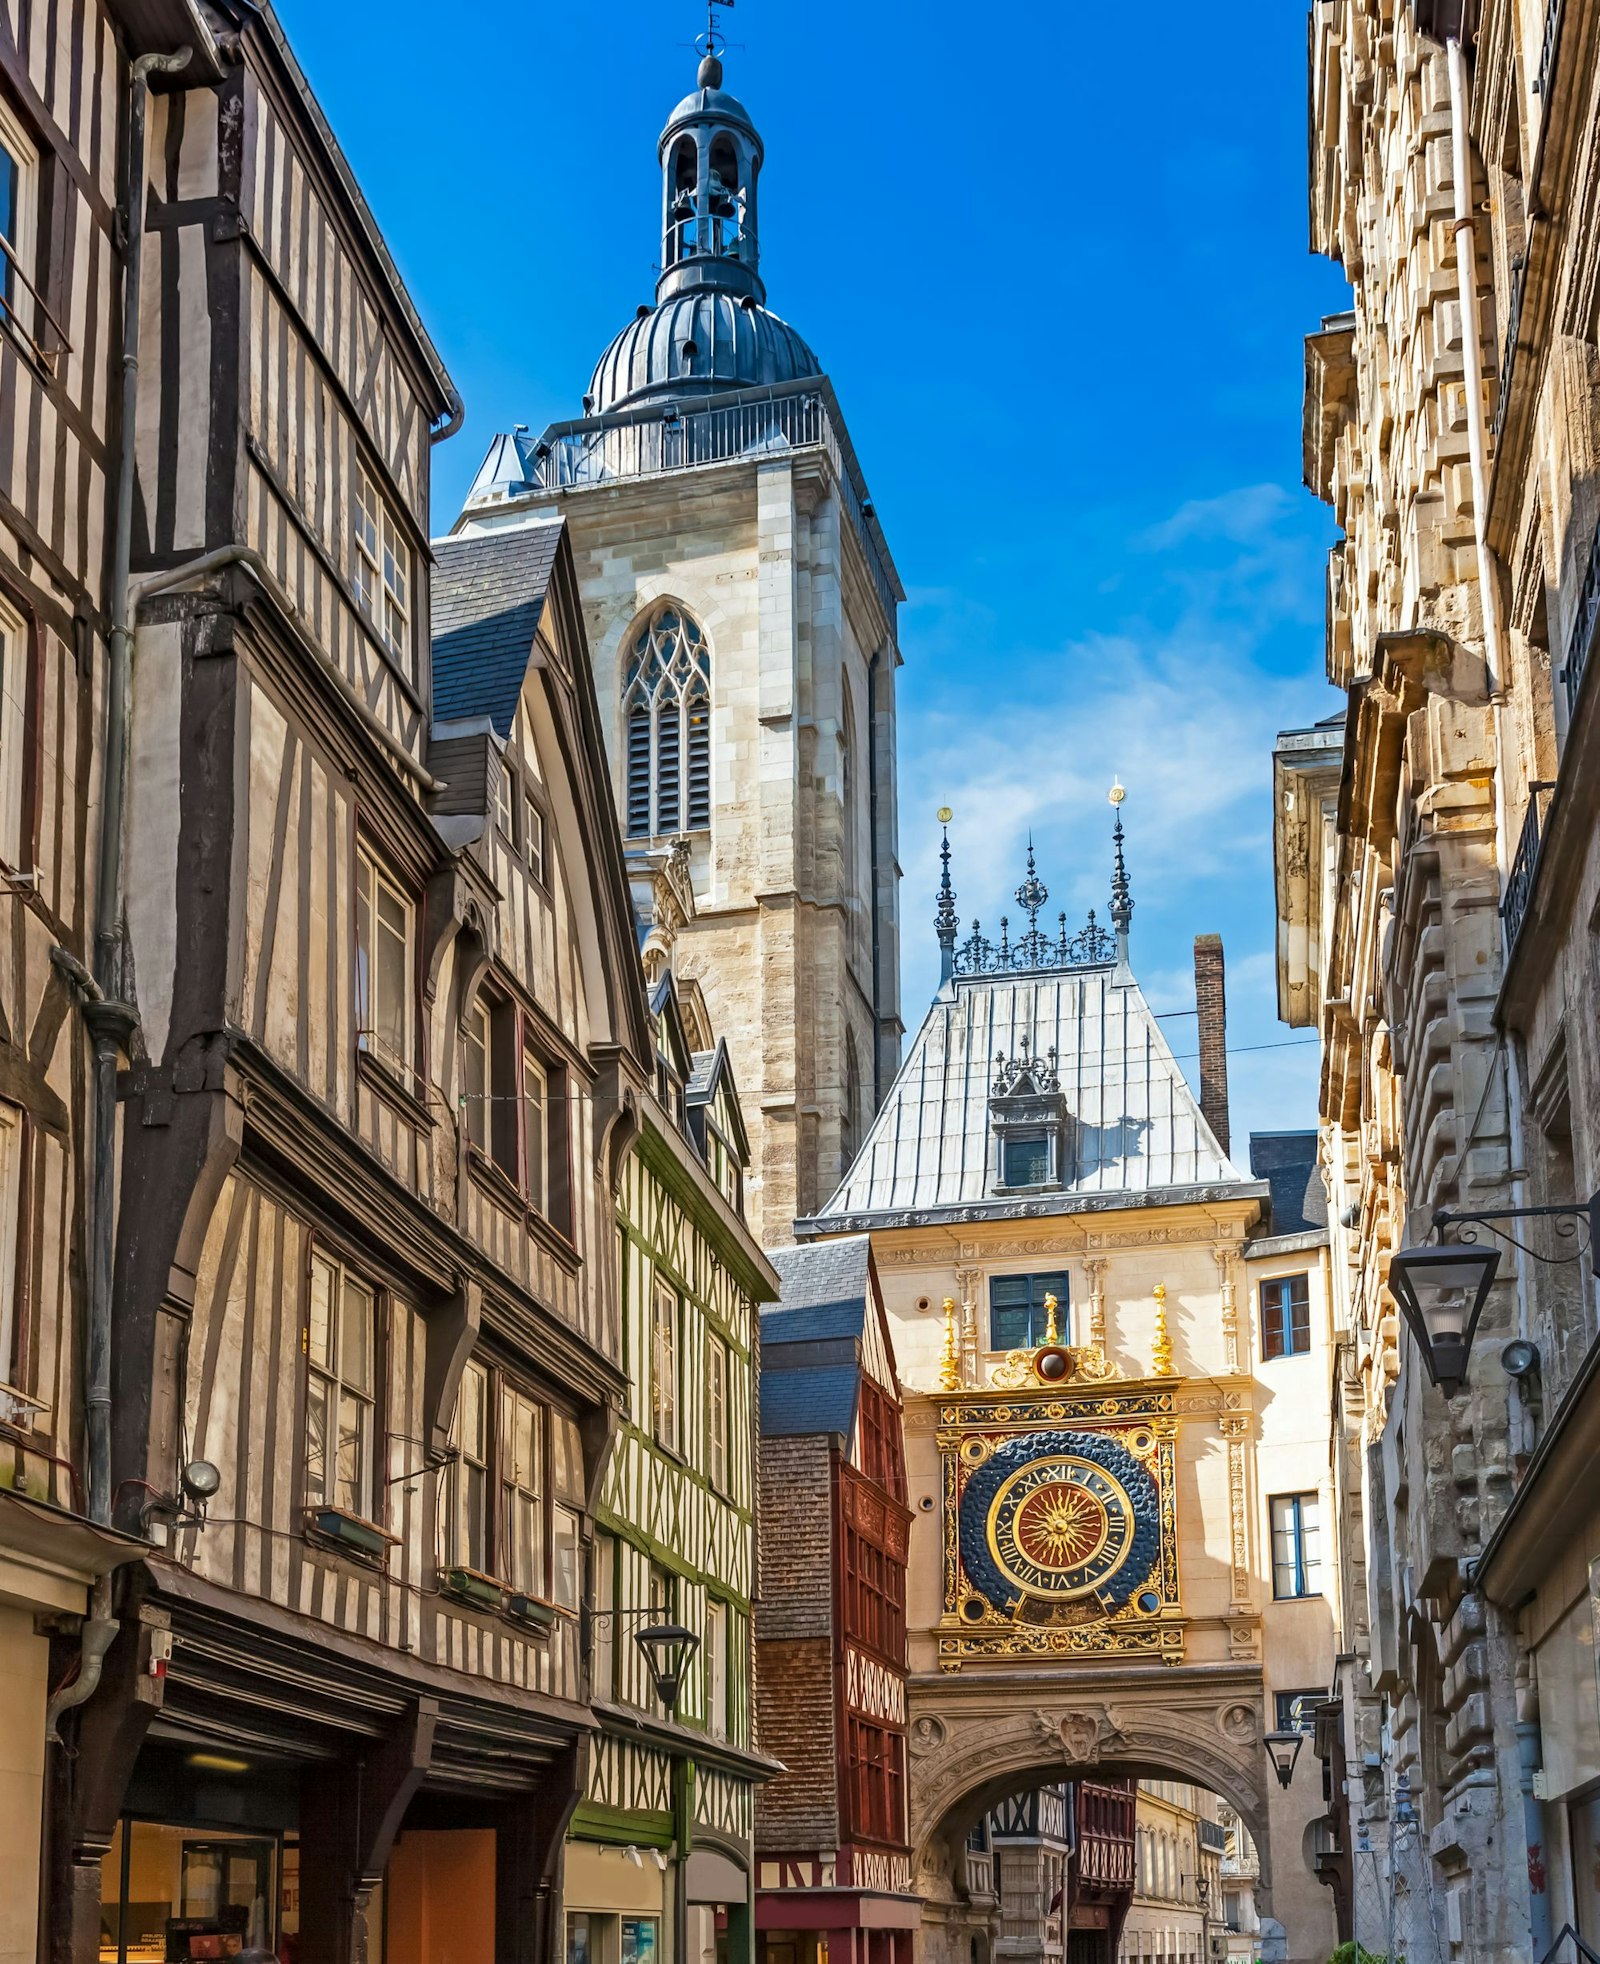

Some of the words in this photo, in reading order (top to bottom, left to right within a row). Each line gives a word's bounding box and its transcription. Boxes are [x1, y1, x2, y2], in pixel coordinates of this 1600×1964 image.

[709, 15, 720, 28] E
[1046, 1466, 1072, 1481] XII
[1082, 1472, 1093, 1486] I
[1019, 1471, 1042, 1493] XI
[1003, 1493, 1021, 1511] X
[1100, 1490, 1118, 1504] II
[997, 1520, 1012, 1540] IX
[1109, 1516, 1125, 1532] III
[1000, 1542, 1022, 1573] VIII
[1098, 1540, 1120, 1565] IIII
[1019, 1564, 1042, 1587] VII
[1050, 1574, 1071, 1589] VI
[1084, 1567, 1099, 1582] V
